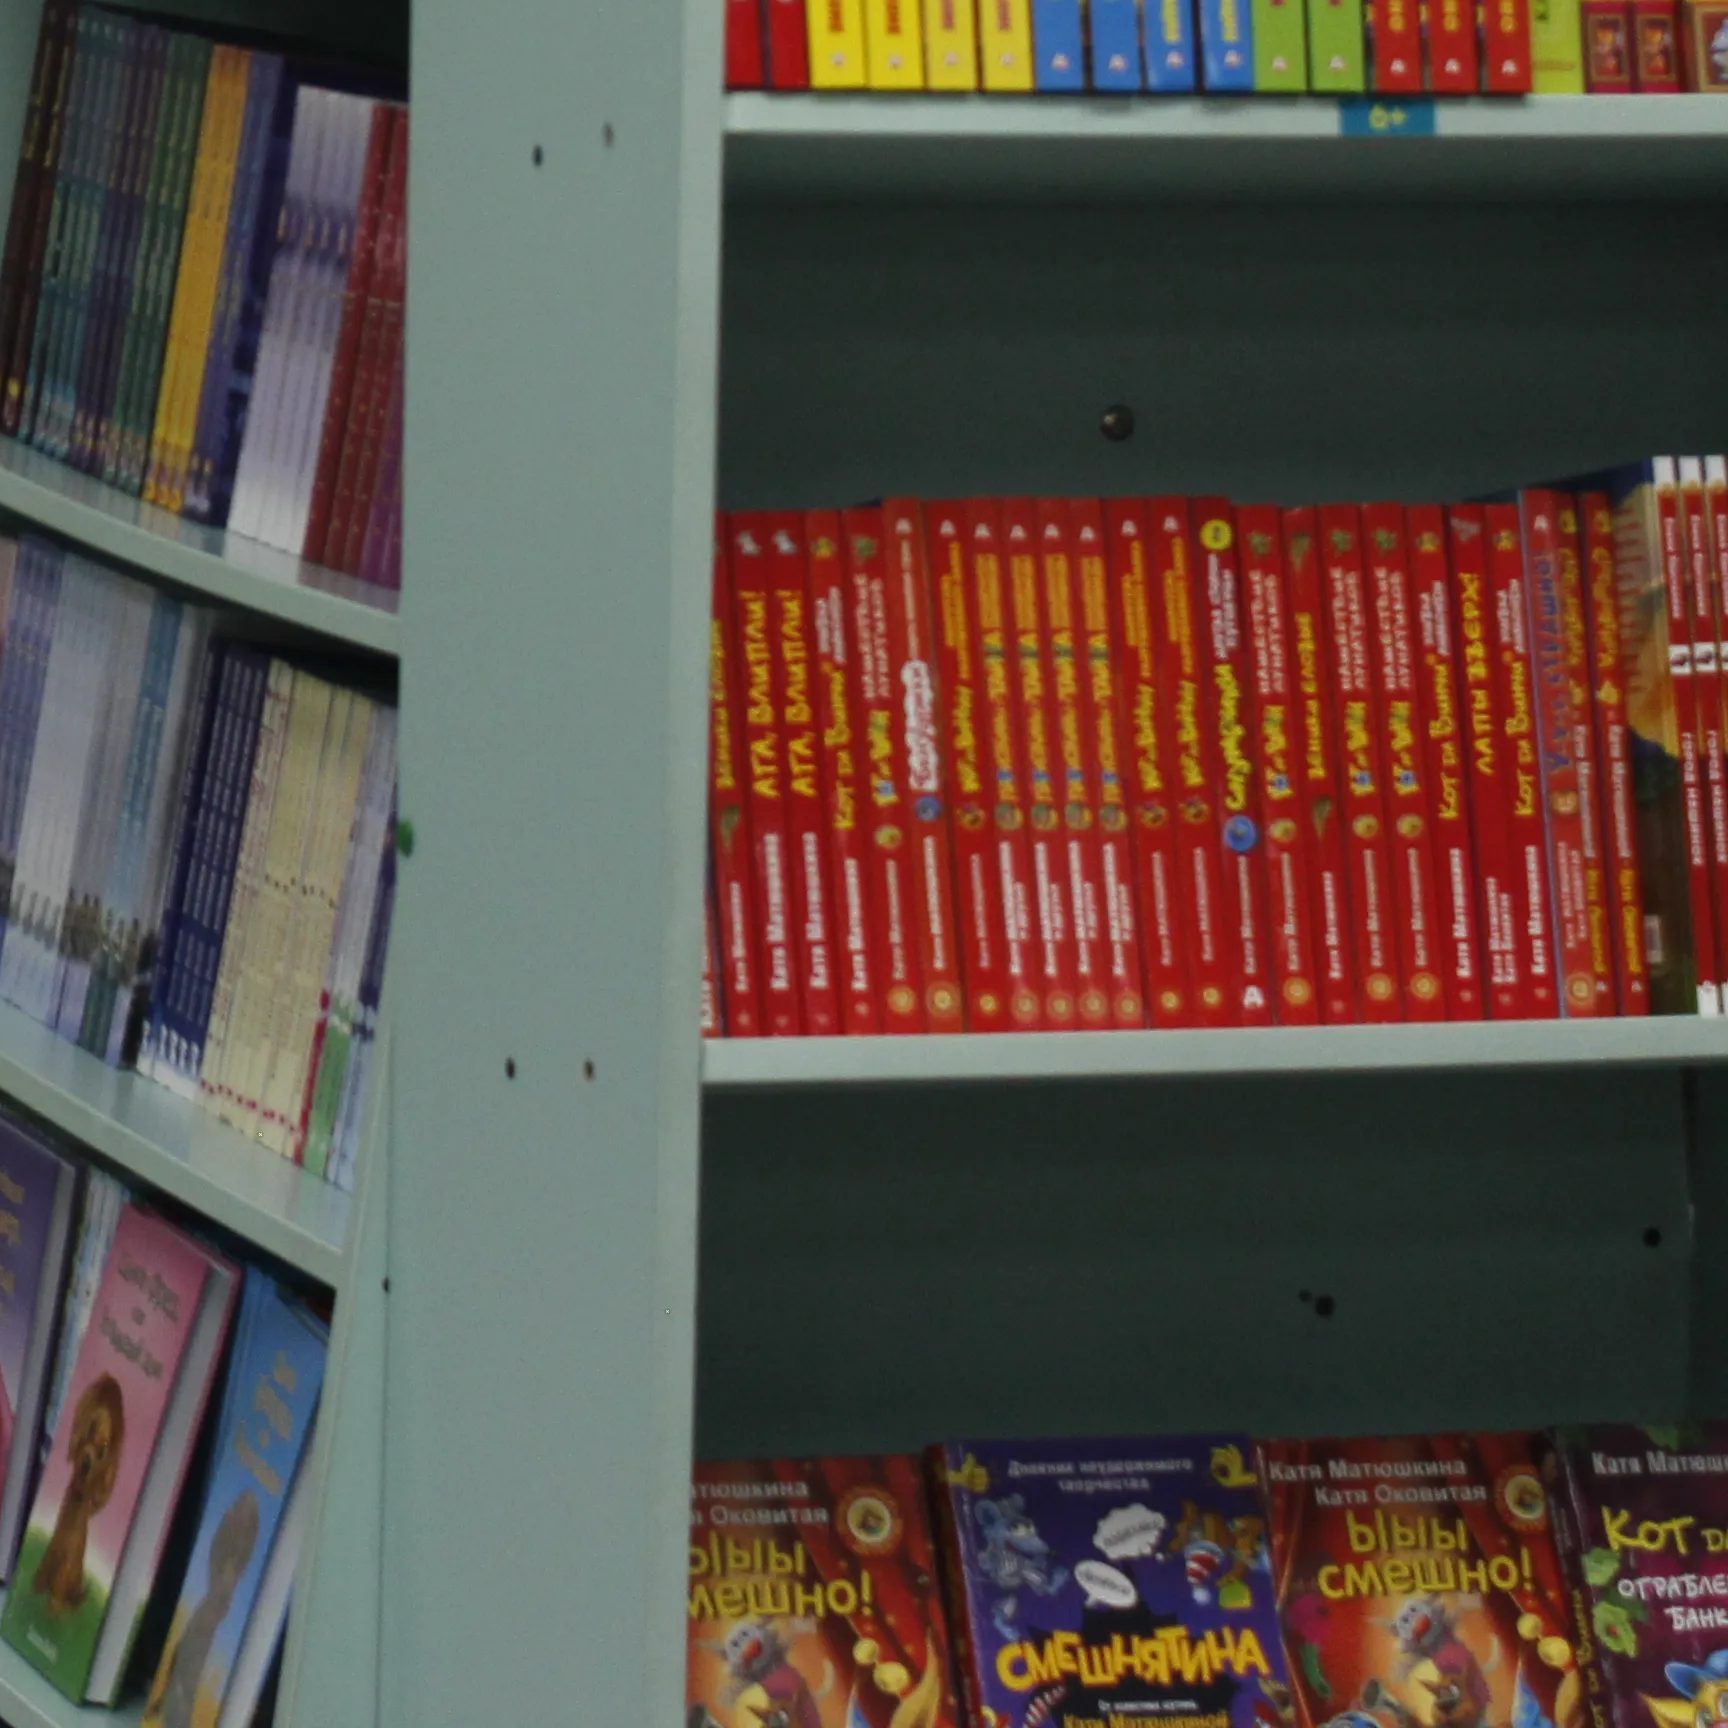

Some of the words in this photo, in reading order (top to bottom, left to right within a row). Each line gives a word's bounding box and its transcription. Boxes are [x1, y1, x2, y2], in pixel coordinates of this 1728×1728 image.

[1269, 1460, 1323, 1481] Катя
[1328, 1457, 1467, 1480] Матюшкина
[1591, 1452, 1640, 1474] Катя
[689, 1479, 809, 1501] тюшкина
[1314, 1485, 1369, 1507] Катя
[1374, 1482, 1487, 1504] Оковитая
[710, 1504, 830, 1527] Оковитая
[995, 1622, 1271, 1693] СМЕШНЯТИНА
